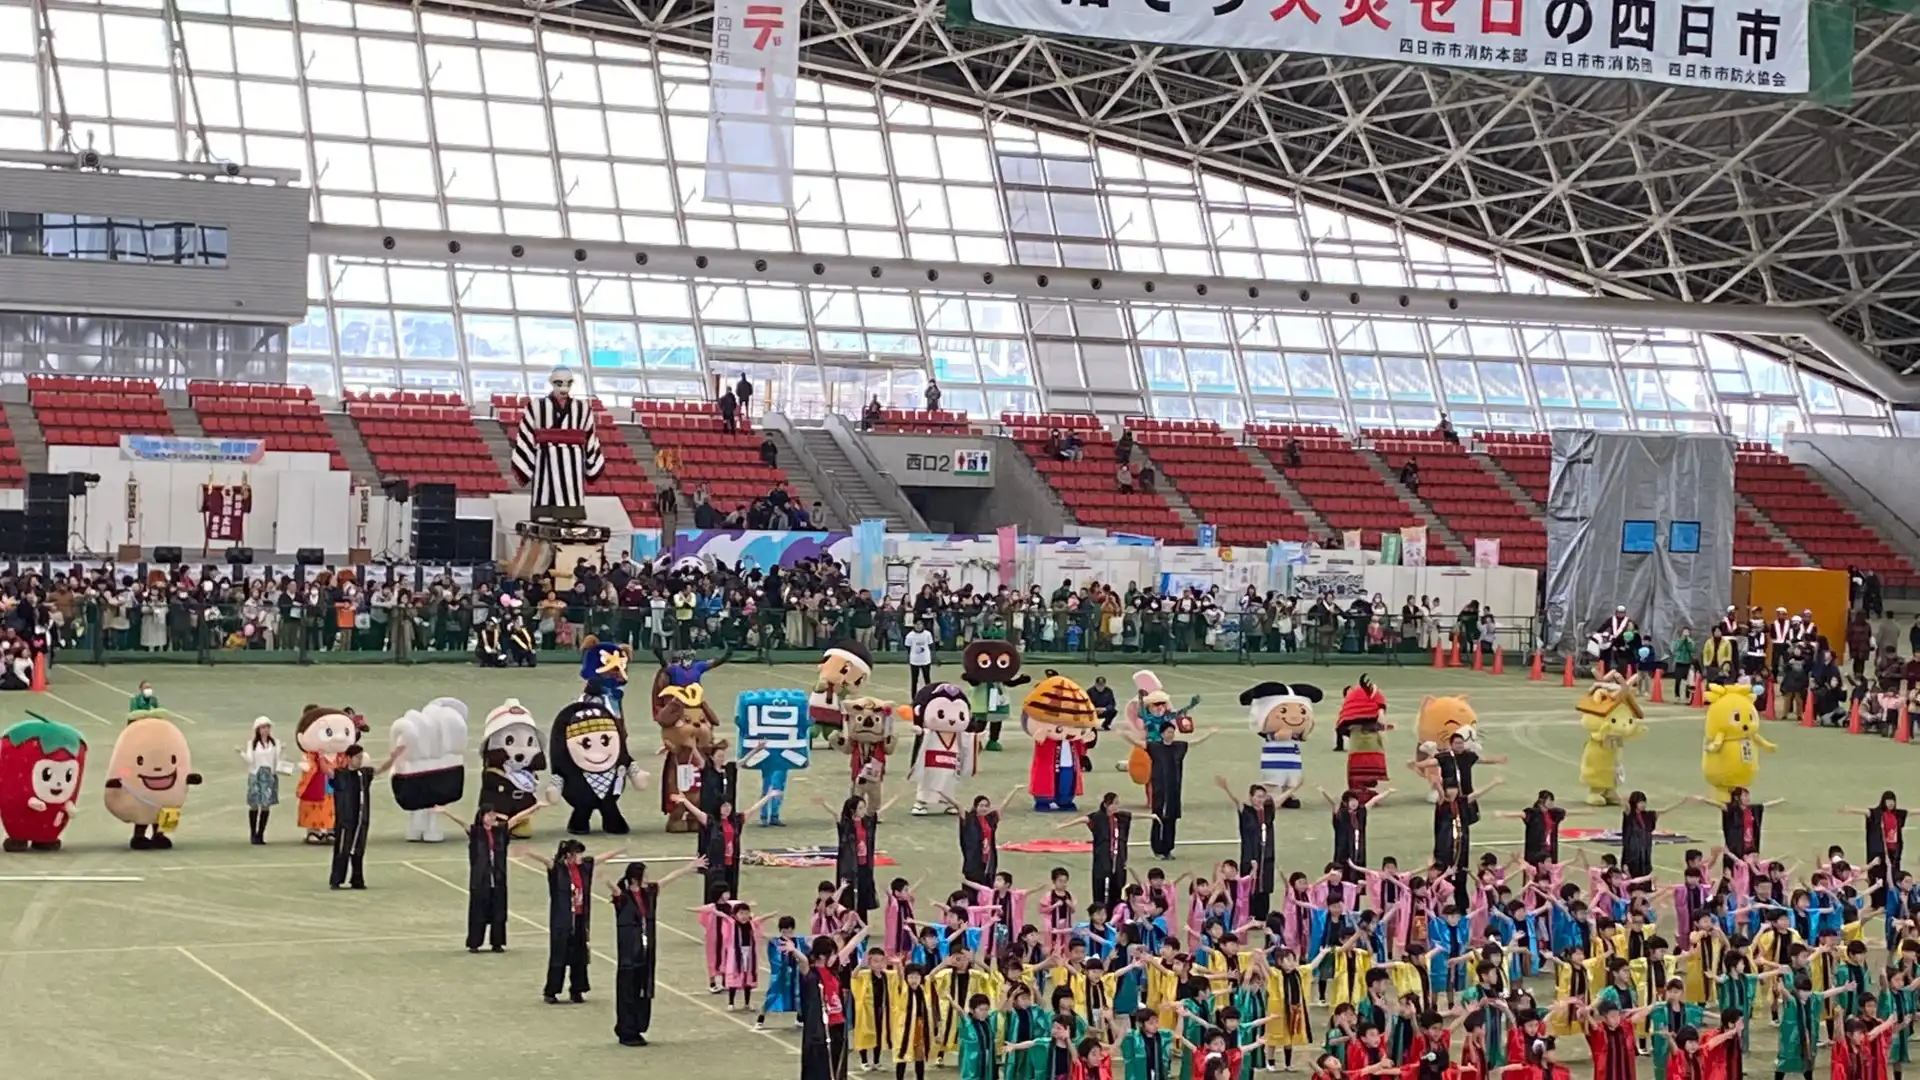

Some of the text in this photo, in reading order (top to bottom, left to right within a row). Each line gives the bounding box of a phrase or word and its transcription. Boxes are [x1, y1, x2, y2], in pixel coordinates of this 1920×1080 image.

[1400, 37, 1529, 65] 四日市市消防本部
[1544, 51, 1653, 74] 四日市市消防団
[1668, 62, 1787, 87] 四日市市防火協会
[906, 453, 950, 472] 西口2
